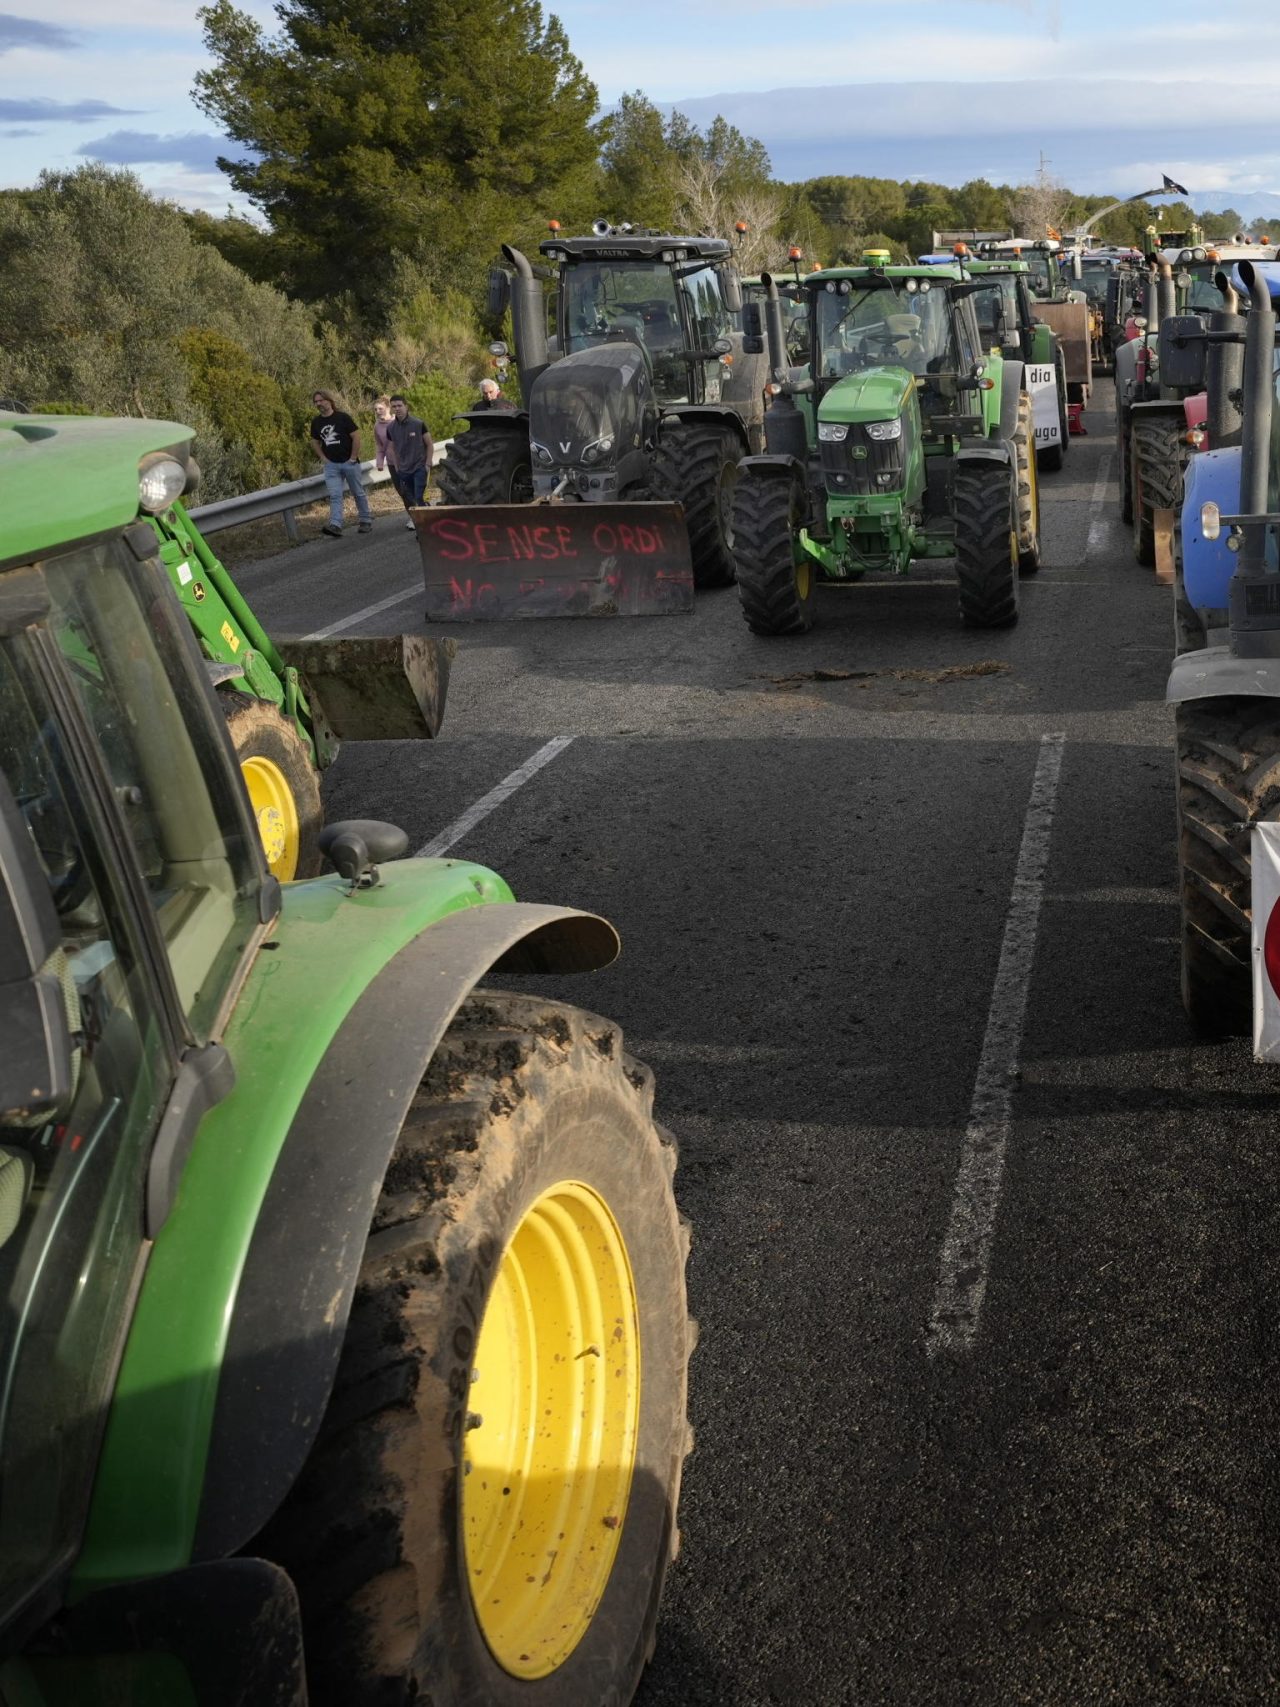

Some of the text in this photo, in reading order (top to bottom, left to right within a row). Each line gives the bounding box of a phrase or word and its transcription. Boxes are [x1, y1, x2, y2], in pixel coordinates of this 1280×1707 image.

[595, 249, 630, 257] VALTRA
[1030, 368, 1051, 383] dia
[1035, 426, 1057, 440] uga
[430, 518, 578, 563] SENSE
